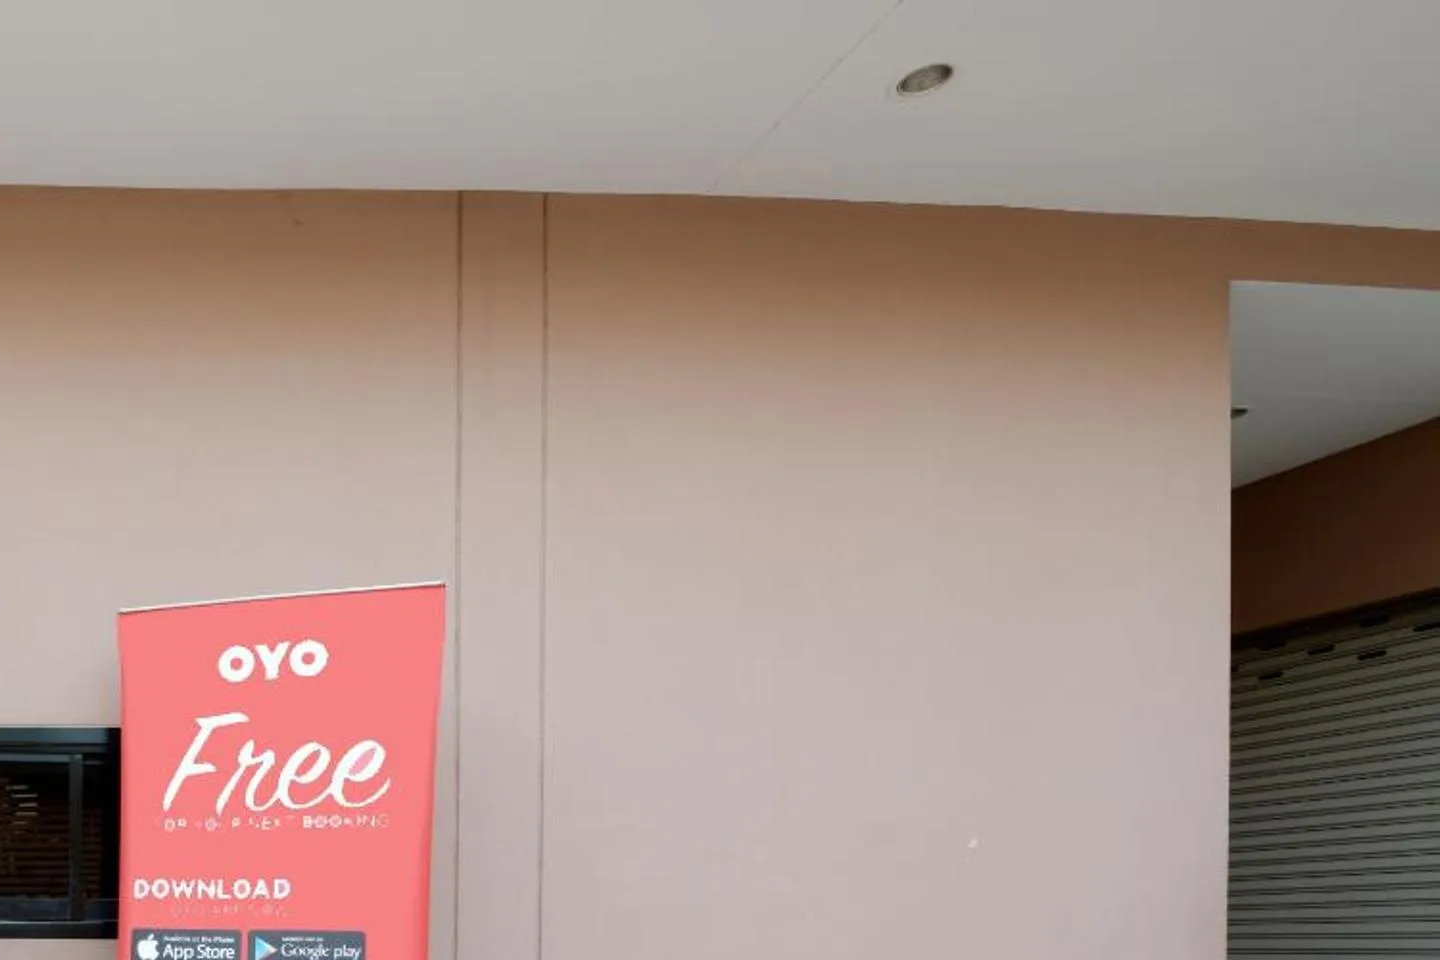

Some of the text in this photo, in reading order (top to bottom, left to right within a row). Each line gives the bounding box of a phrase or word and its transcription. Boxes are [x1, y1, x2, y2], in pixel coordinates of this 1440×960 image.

[217, 639, 329, 684] OYO
[162, 711, 391, 816] Free
[133, 878, 292, 900] DOWNLOAD
[196, 944, 235, 959] Store
[281, 943, 330, 960] Google
